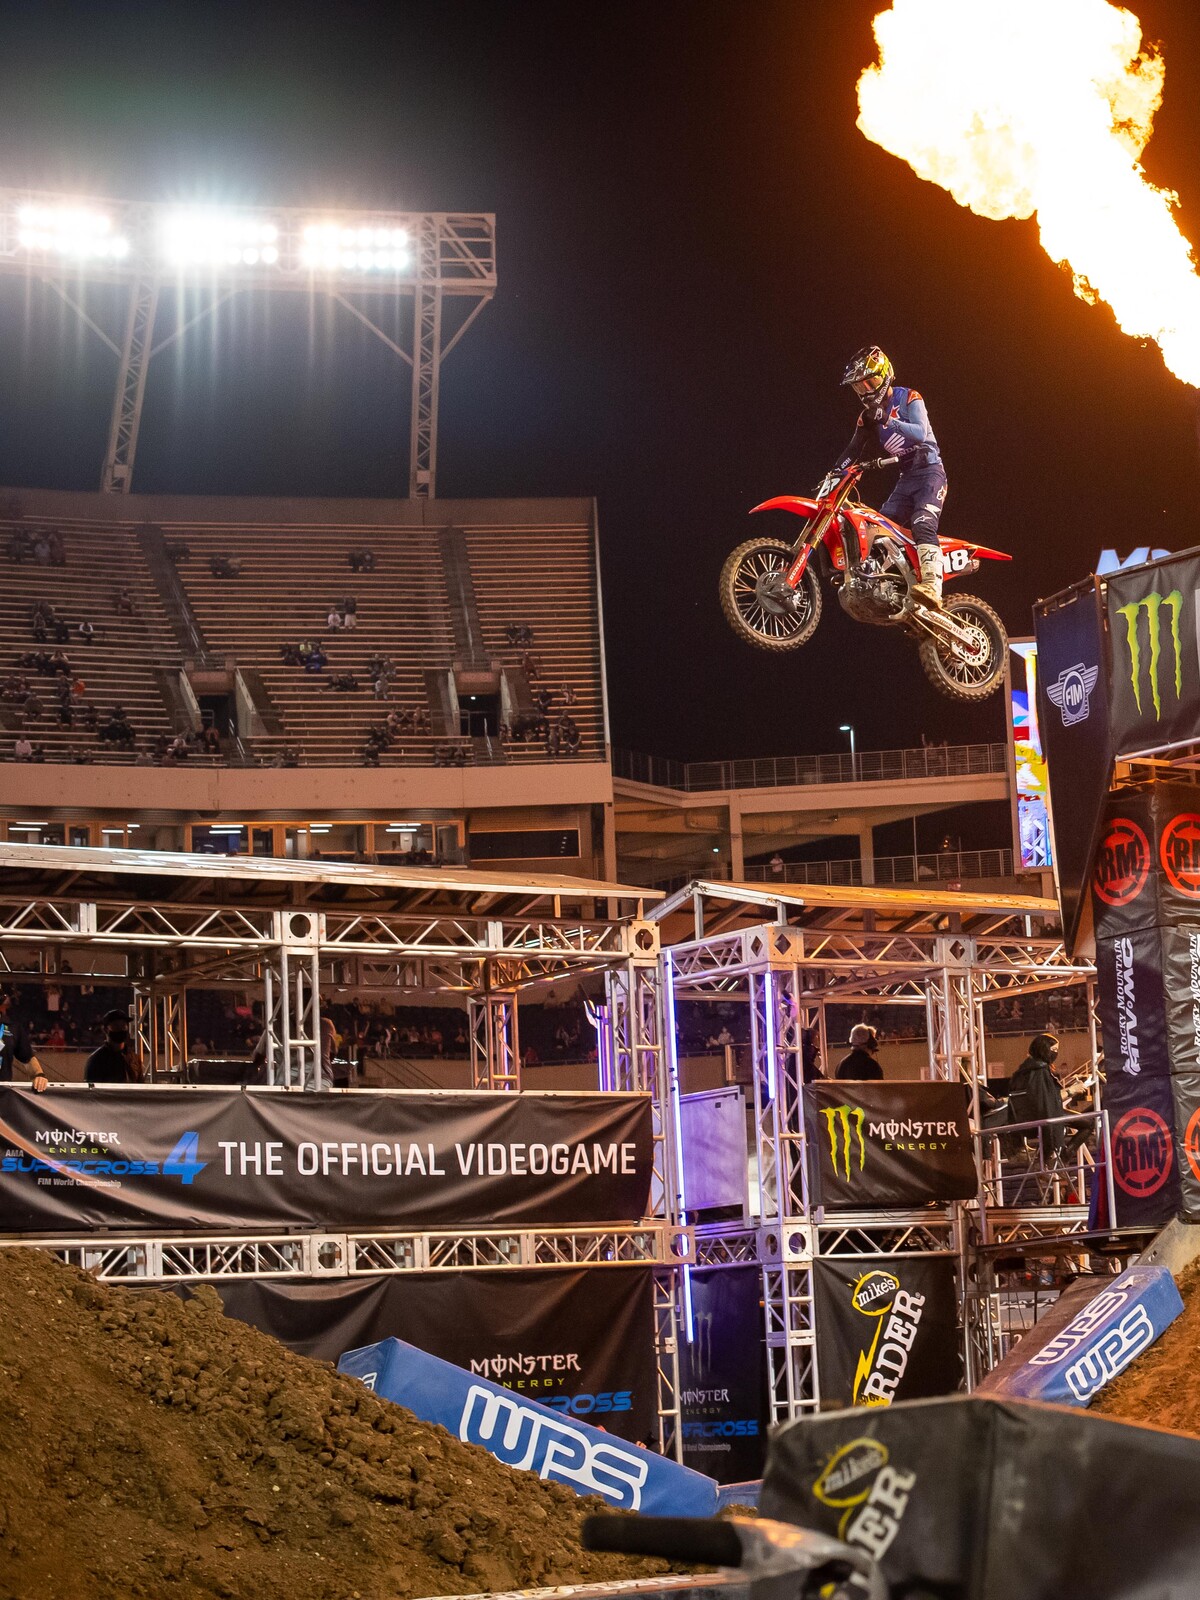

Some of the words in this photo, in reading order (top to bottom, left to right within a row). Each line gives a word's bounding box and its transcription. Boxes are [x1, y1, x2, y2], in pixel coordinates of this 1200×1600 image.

[1066, 683, 1083, 706] FIM
[1113, 939, 1127, 1011] MOUNTAIN
[1188, 932, 1200, 1004] MOUNTAIN
[1119, 1012, 1129, 1055] ROCKY
[34, 1128, 121, 1146] MONSTER
[868, 1118, 960, 1140] MONSTER
[1, 1157, 160, 1175] SUPERCROSS
[163, 1131, 208, 1185] 4
[5, 1149, 24, 1158] AMA
[218, 1141, 284, 1176] THE
[298, 1142, 445, 1176] OFFICIAL
[454, 1142, 637, 1176] VIDEOGAME
[885, 1143, 948, 1151] ENERGY
[37, 1178, 52, 1186] FIM
[54, 1178, 75, 1186] World
[76, 1178, 121, 1188] Championship
[857, 1277, 896, 1307] mike's
[1028, 1291, 1128, 1365] WPS
[469, 1352, 582, 1378] MONSTER
[1064, 1303, 1154, 1401] WPS
[500, 1377, 565, 1389] NERGY
[459, 1384, 649, 1511] WPS
